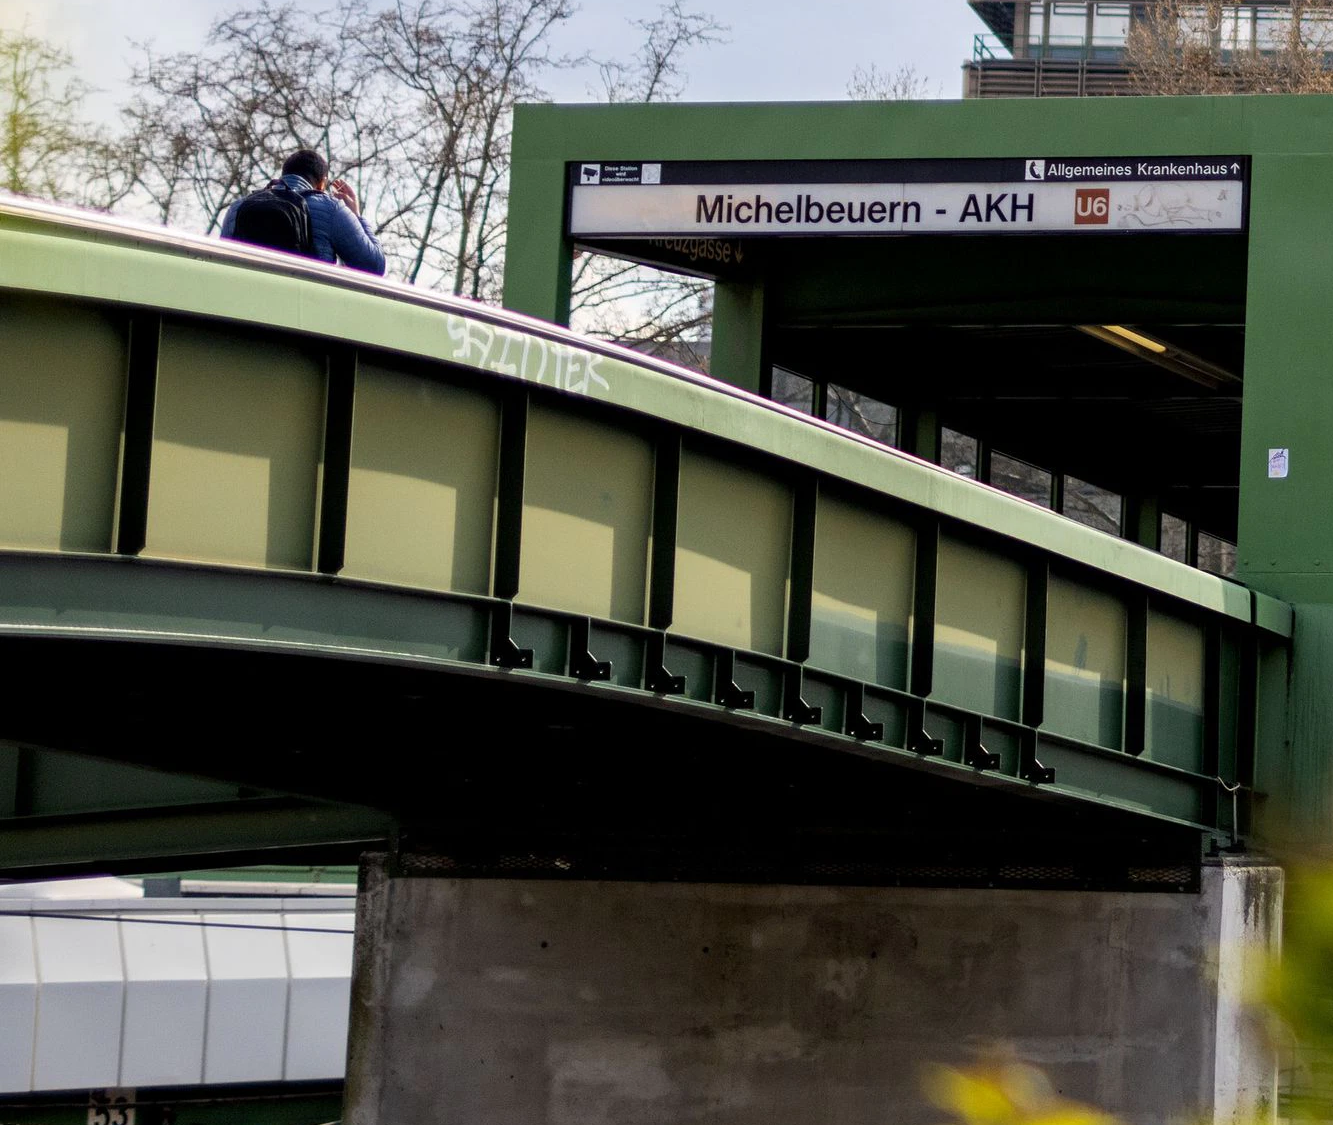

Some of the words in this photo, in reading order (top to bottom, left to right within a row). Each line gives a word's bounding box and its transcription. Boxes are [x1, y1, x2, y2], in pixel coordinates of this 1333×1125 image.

[1048, 163, 1132, 178] Allgemeines
[1138, 162, 1228, 175] Krankenhaus
[695, 194, 921, 224] Michelbeuern
[959, 193, 1034, 223] AKH
[1076, 196, 1108, 217] U6
[649, 237, 731, 263] reuzgasse
